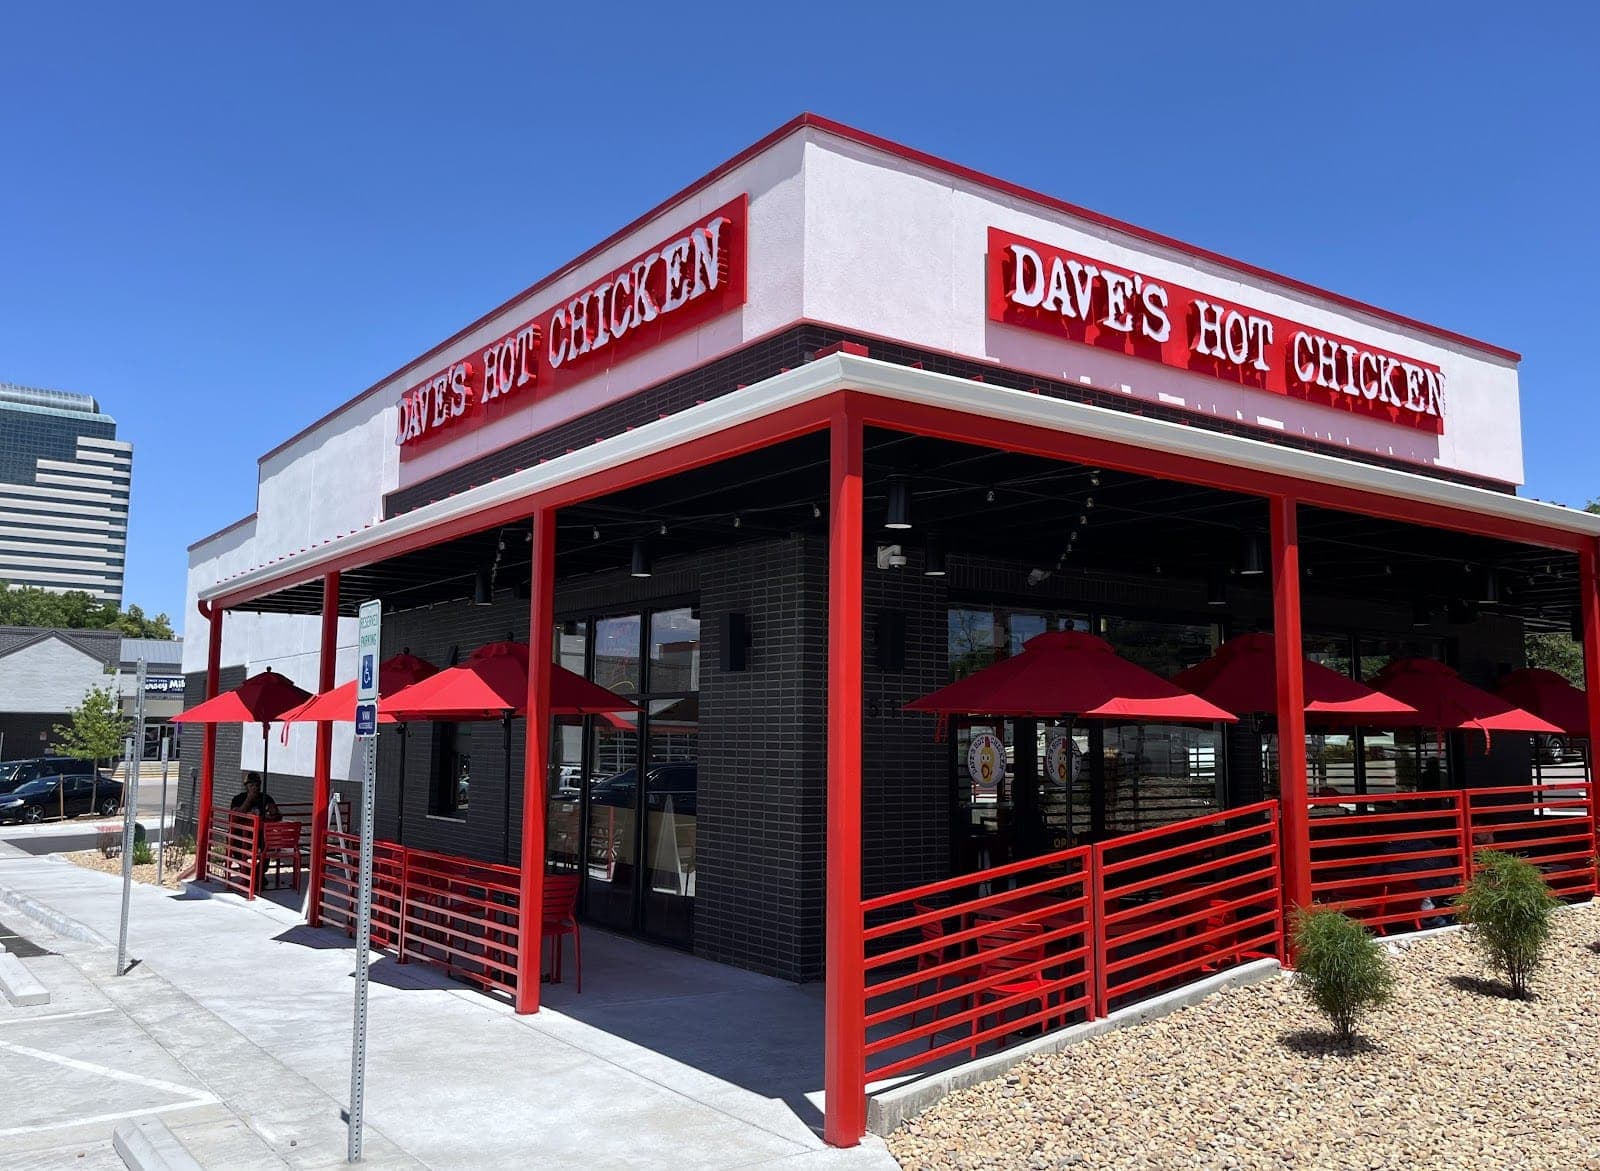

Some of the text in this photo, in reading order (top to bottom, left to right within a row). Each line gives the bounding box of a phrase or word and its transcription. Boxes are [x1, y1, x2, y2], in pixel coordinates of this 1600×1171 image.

[395, 217, 727, 446] DAVE'S HOT CHICKEN
[1010, 244, 1446, 418] DAVE'S HOT CHICKEN
[145, 682, 168, 692] ersey
